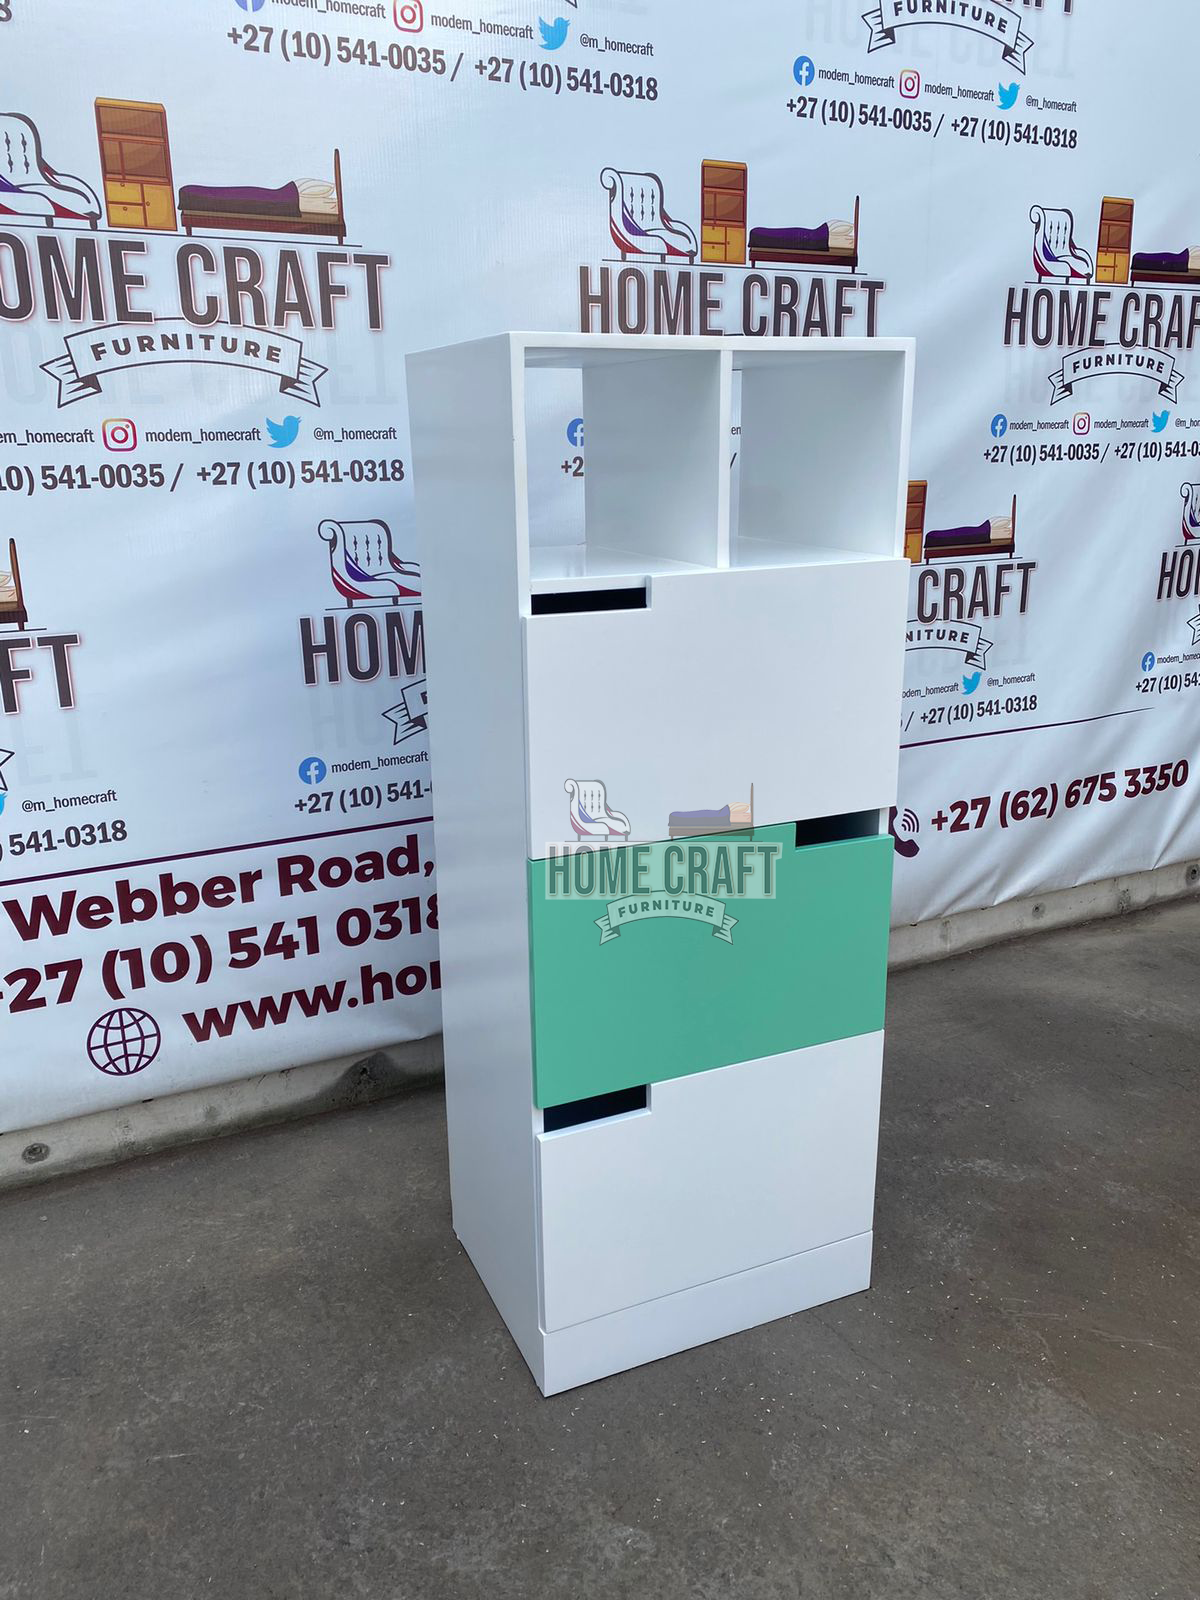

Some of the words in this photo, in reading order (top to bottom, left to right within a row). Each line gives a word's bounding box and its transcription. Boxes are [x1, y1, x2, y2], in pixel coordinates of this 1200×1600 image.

[893, 0, 1008, 34] FURNITURE
[580, 33, 654, 57] @m_homecraft
[227, 24, 274, 54] +27
[280, 30, 331, 66] (10)
[337, 36, 446, 75] 541-0035
[474, 57, 515, 83] +27
[519, 60, 562, 94] (10)
[566, 67, 658, 101] 541-0318
[1025, 94, 1077, 113] @m_homecraft
[786, 95, 818, 118] +27
[821, 98, 855, 126] (10)
[858, 103, 932, 132] 541-0035
[951, 116, 979, 137] +27
[981, 117, 1011, 145] (10)
[1013, 122, 1077, 149] 541-0318
[0, 232, 153, 324] OME
[176, 244, 390, 331] CRAFT
[579, 265, 724, 336] HOME
[742, 273, 885, 337] CRAFT
[1003, 287, 1111, 347] HOME
[1119, 292, 1200, 349] CRAF
[90, 334, 282, 363] FURNITURE
[1072, 353, 1165, 374] FURNITURE
[313, 427, 397, 443] @m_homecraft
[561, 455, 584, 477] +2
[983, 446, 1008, 463] +27
[1010, 444, 1036, 465] (10)
[1039, 443, 1099, 461] 541-0035
[1114, 442, 1136, 459] +27
[1137, 441, 1162, 462] (10)
[1164, 440, 1200, 458] 541-0
[41, 463, 165, 490] 541-0035
[196, 463, 241, 487] +27
[248, 461, 296, 490] (10)
[300, 459, 404, 484] 541-0318
[1157, 549, 1200, 600] HO
[917, 562, 1036, 624] CRAFT
[299, 610, 426, 684] HOM
[905, 629, 969, 643] NITURE
[987, 673, 1036, 688] @m_homecraft
[1136, 677, 1157, 693] +27
[1158, 674, 1182, 694] (10)
[920, 707, 945, 725] +27
[947, 703, 974, 725] (10)
[976, 694, 1038, 717] 541-0318
[22, 790, 117, 812] @m_homecraft
[294, 791, 334, 814] +27
[339, 785, 382, 813] (10)
[387, 779, 433, 803] 541-
[931, 796, 991, 833] +27
[1000, 783, 1058, 828] (62)
[1065, 771, 1117, 809] 675
[1124, 759, 1189, 799] 3350
[9, 819, 127, 856] 541-0318
[2, 873, 262, 942] Webber
[277, 834, 434, 897] Road,
[0, 958, 83, 1014] 27
[102, 934, 213, 999] (10)
[228, 915, 320, 969] 541
